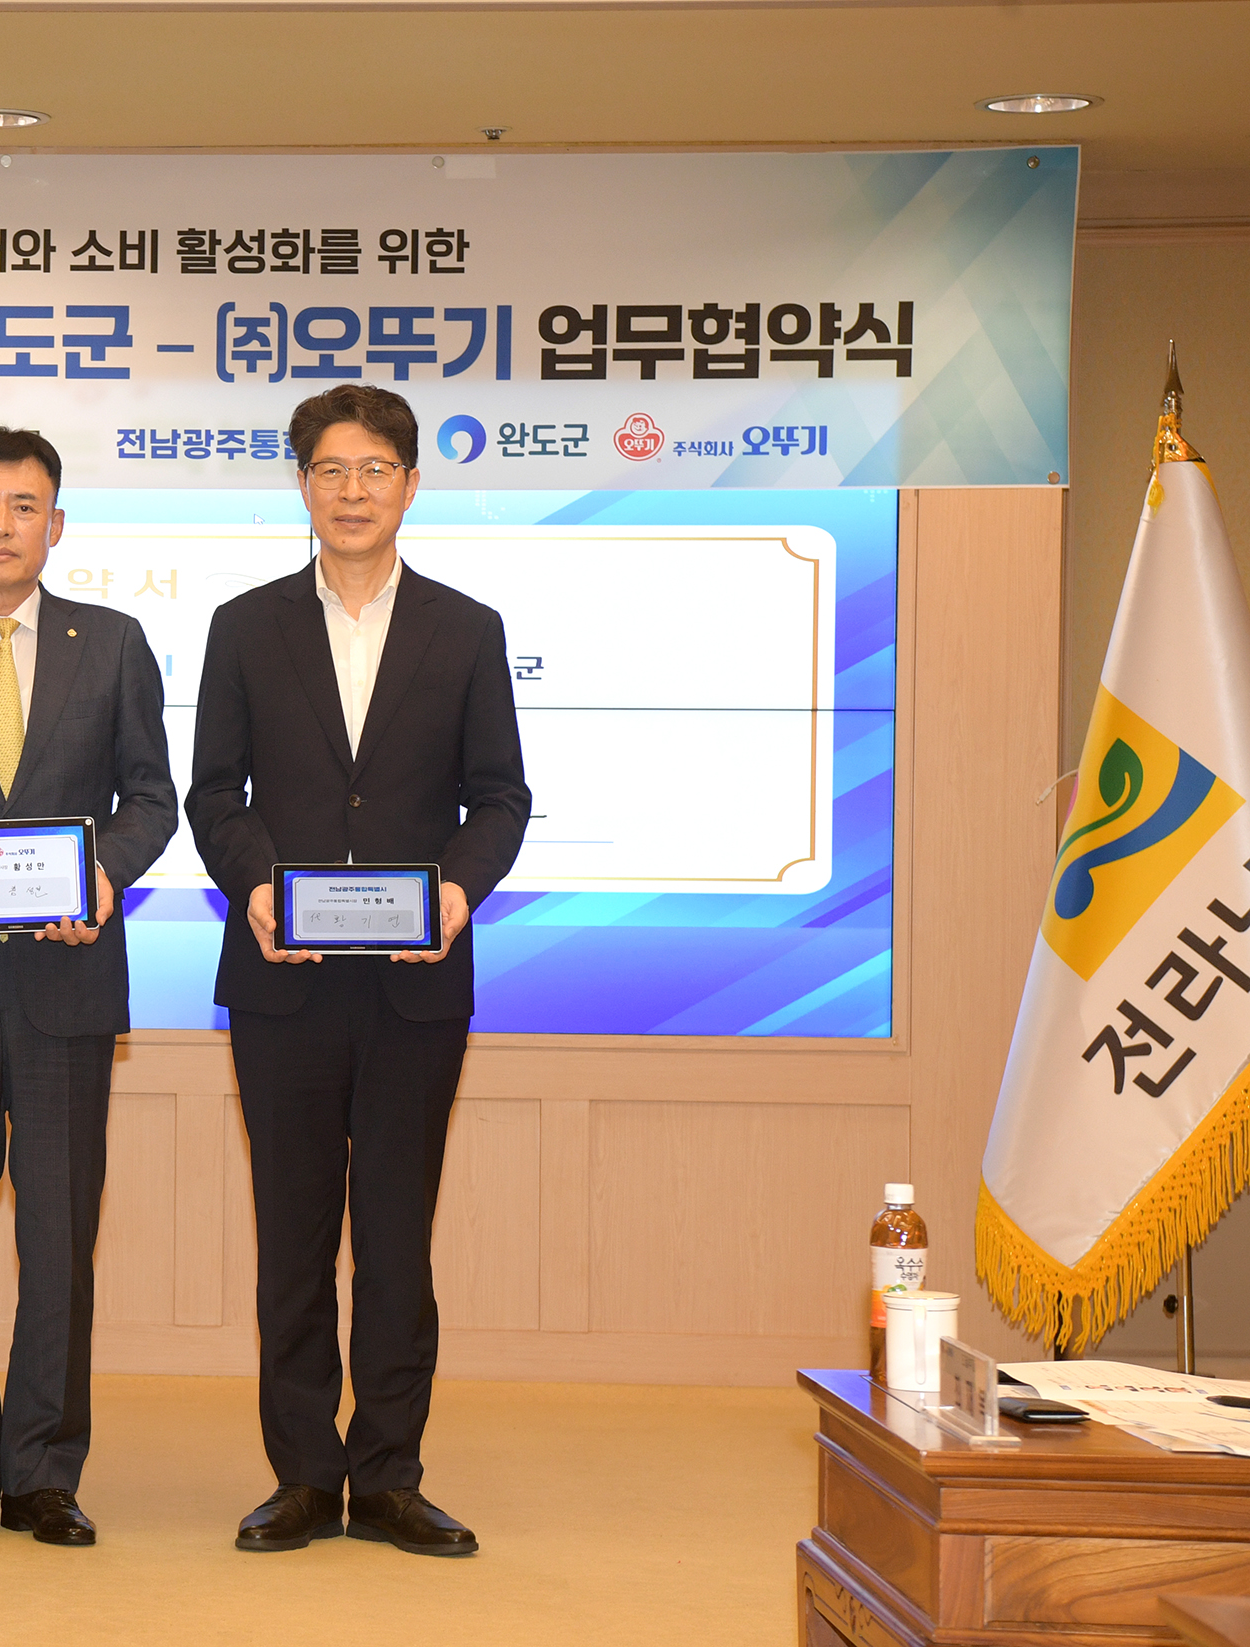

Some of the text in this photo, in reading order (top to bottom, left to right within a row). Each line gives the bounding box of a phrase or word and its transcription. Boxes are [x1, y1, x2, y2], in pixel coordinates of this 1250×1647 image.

[69, 229, 159, 274] 소비
[176, 227, 362, 275] 활성화를
[377, 227, 470, 275] 위한
[216, 301, 513, 383] (주)오뚜기
[538, 300, 914, 381] 업무협약식
[496, 422, 590, 458] 완도군
[623, 438, 655, 452] 오뚜기
[672, 425, 828, 457] 주식회사 오뚜기
[894, 1256, 924, 1272] 옥수수
